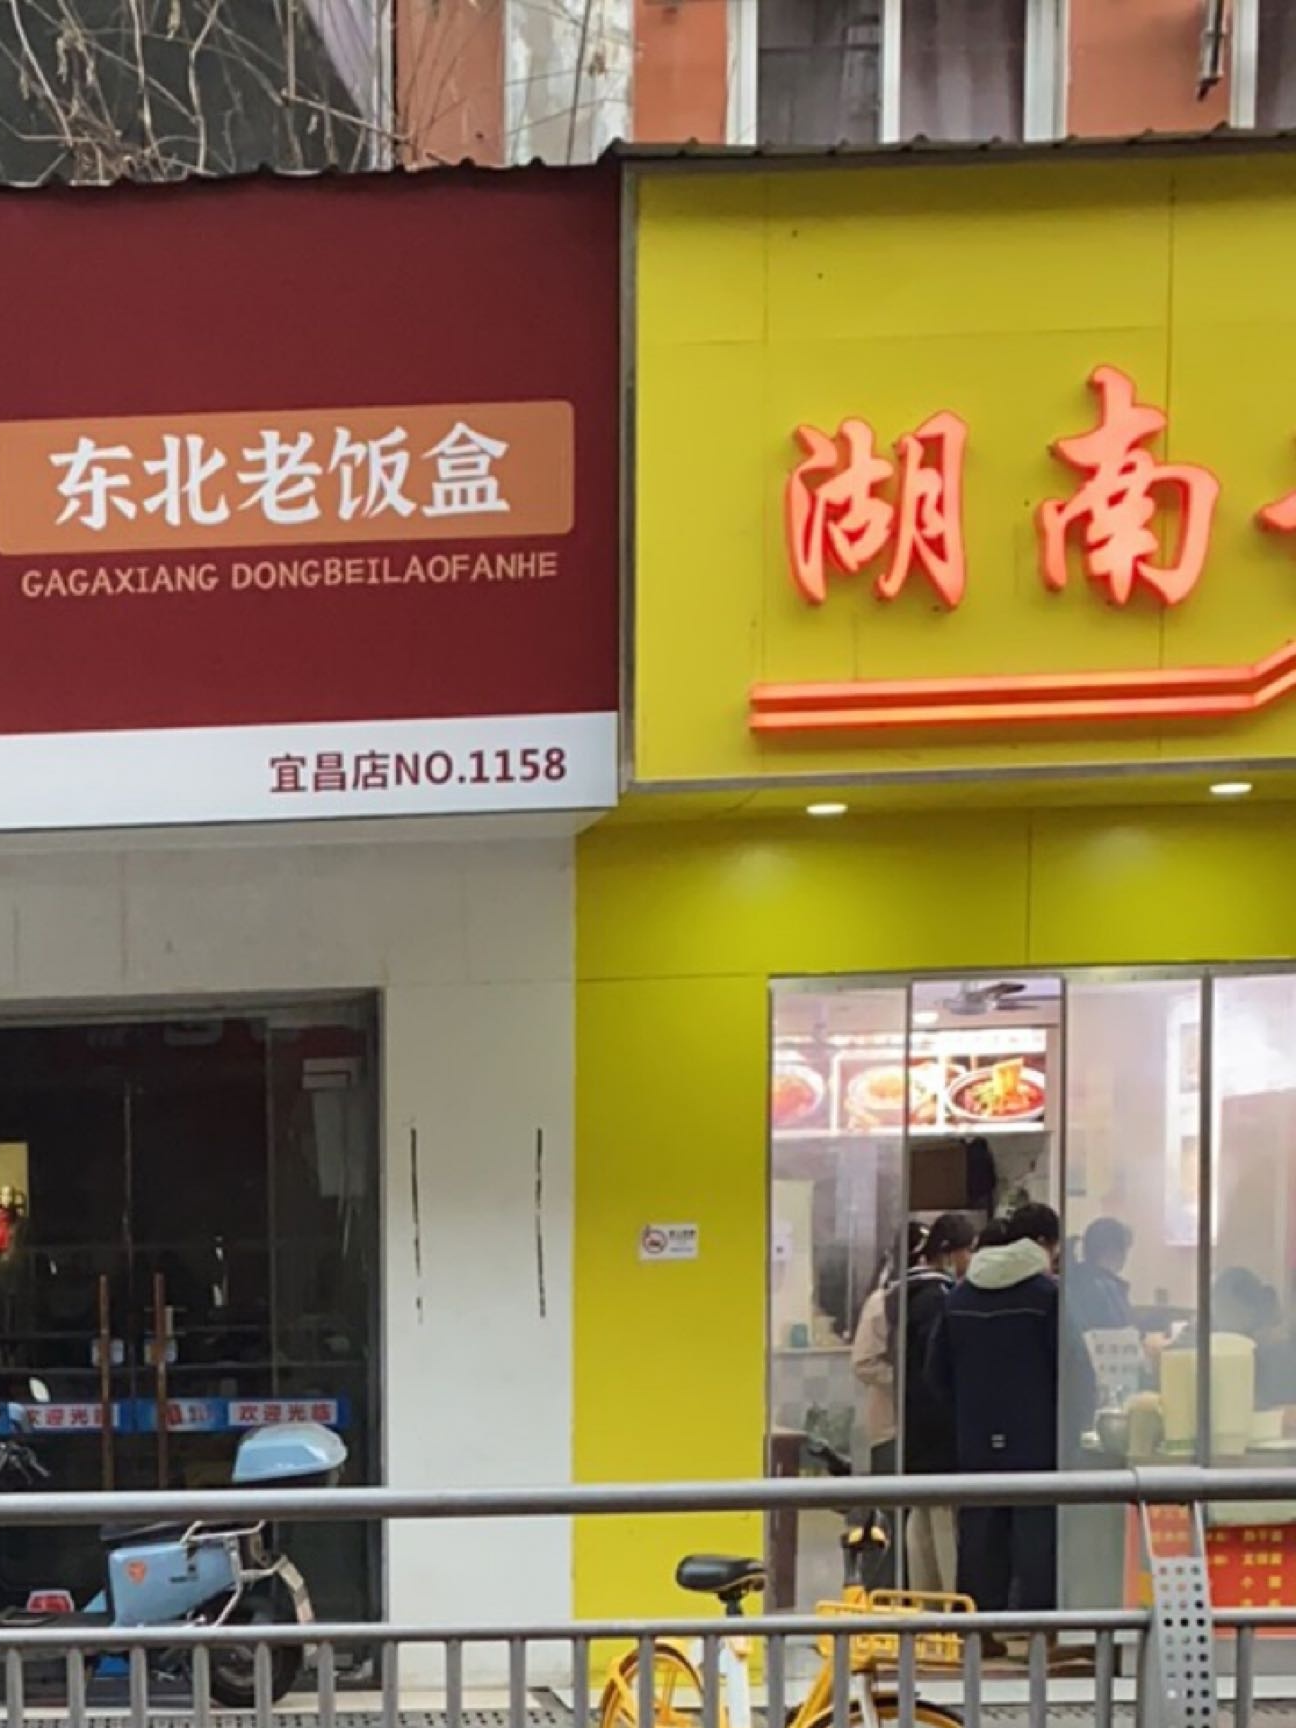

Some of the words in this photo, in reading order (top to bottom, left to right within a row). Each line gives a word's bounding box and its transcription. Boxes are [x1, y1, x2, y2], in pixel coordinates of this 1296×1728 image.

[49, 421, 510, 531] 东北老饭盒
[784, 364, 1296, 612] 湖南
[21, 562, 219, 598] GAGAXIANG
[232, 551, 558, 591] DONGBEILAOFANHE
[269, 747, 566, 794] 宜昌店NO.1158
[239, 1403, 332, 1422] 欢迎光临
